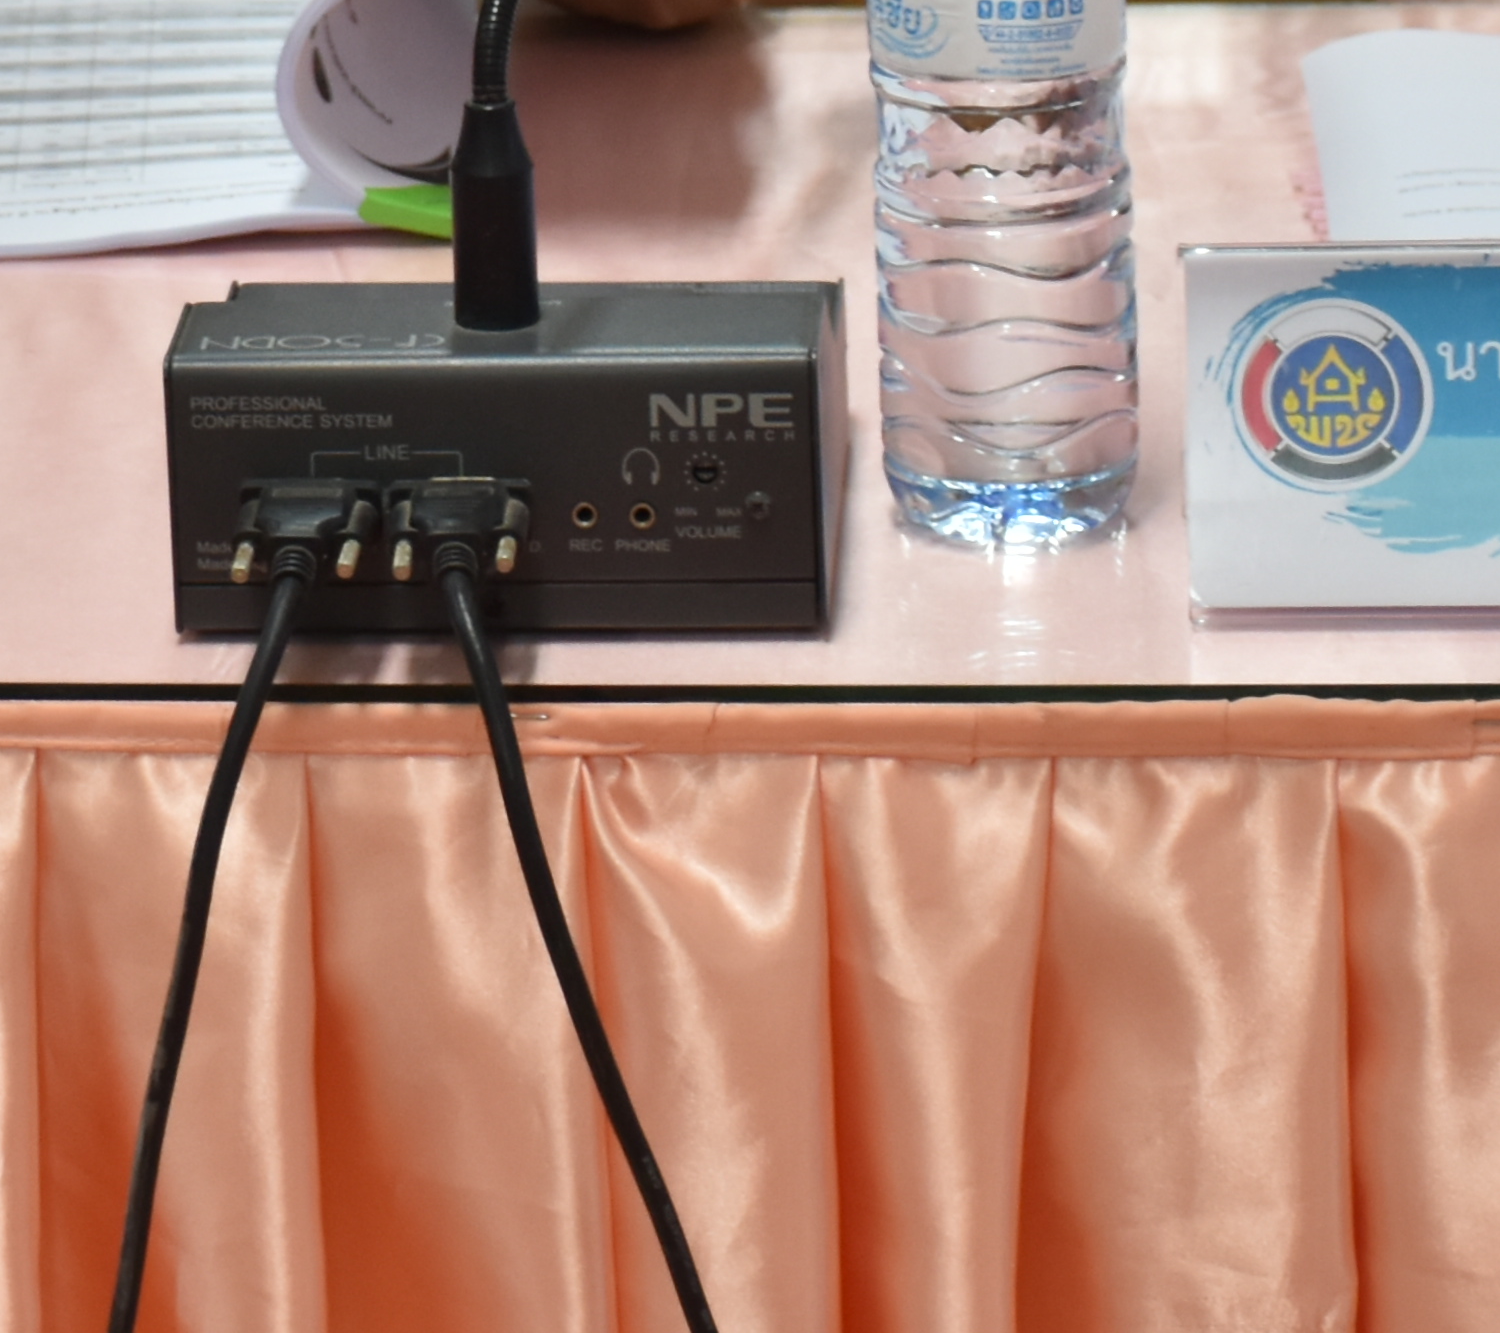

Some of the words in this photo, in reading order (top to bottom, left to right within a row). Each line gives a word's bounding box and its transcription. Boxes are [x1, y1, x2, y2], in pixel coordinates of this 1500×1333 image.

[189, 396, 327, 411] PROFESSIONAL
[649, 392, 795, 428] NPE
[190, 414, 313, 429] CONFERENCE
[319, 414, 393, 428] SYSTEM
[649, 430, 796, 443] RESEARCH
[364, 444, 410, 462] LINE
[675, 525, 743, 539] VOLUME
[568, 538, 604, 552] REC
[614, 538, 671, 552] PHONE
